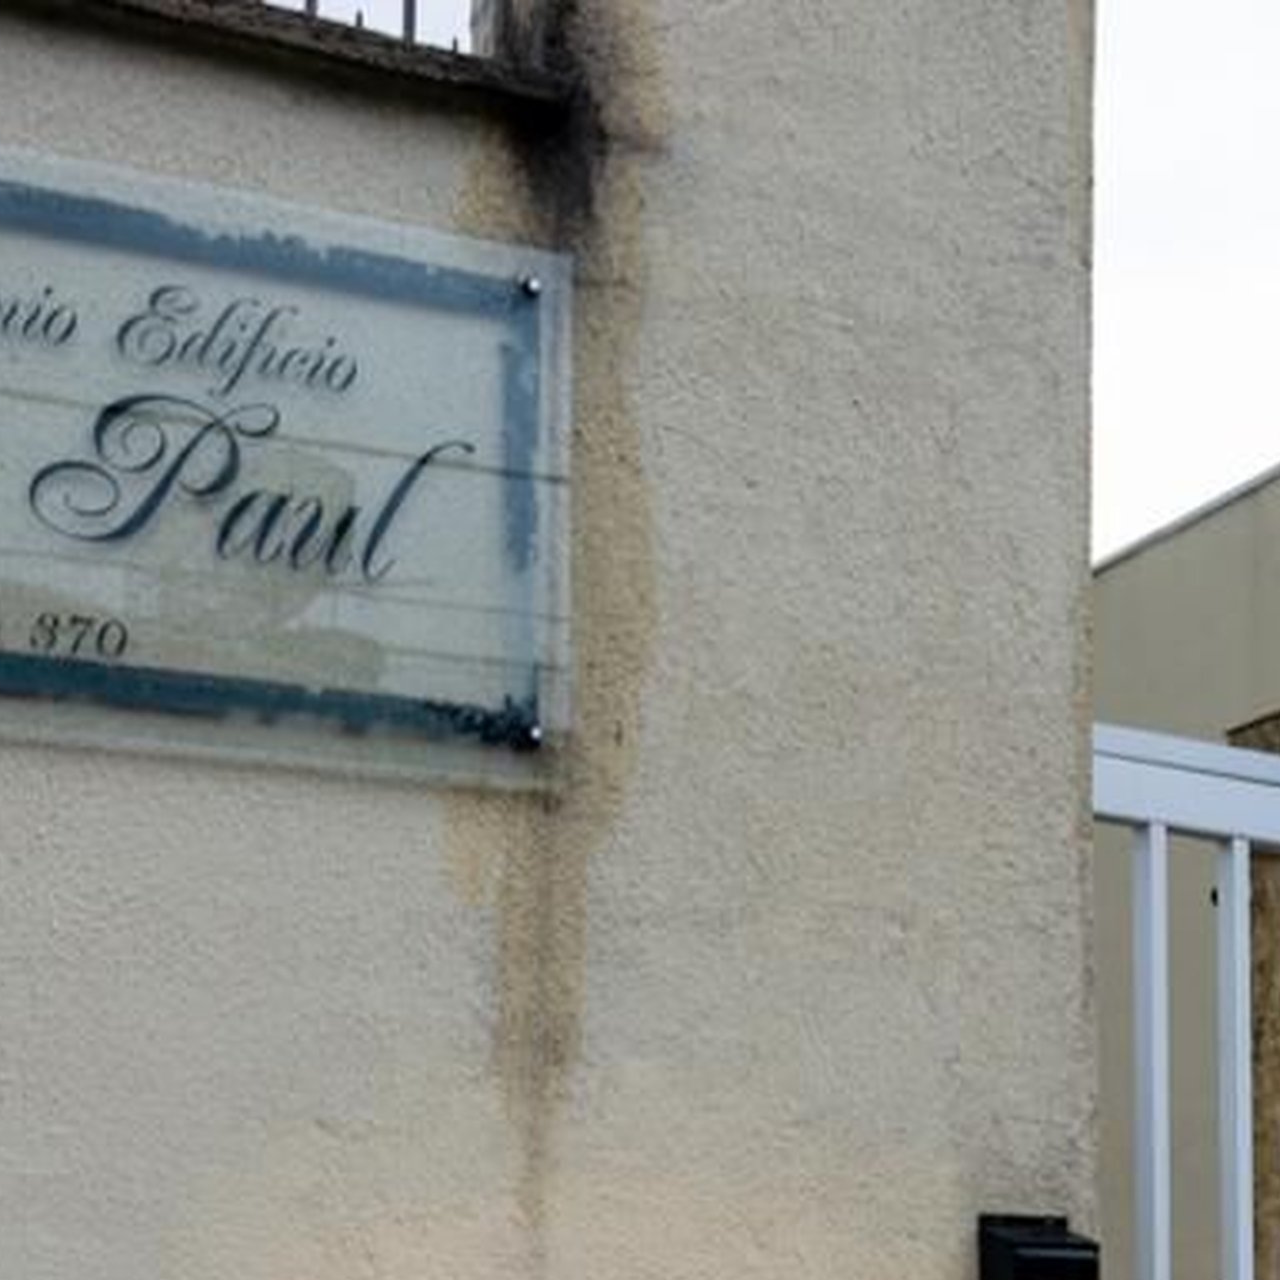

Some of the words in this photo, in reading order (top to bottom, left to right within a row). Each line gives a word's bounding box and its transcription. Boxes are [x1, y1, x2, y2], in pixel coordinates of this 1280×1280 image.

[116, 284, 358, 397] Edificio
[29, 394, 475, 582] Paul
[29, 611, 128, 656] 370
